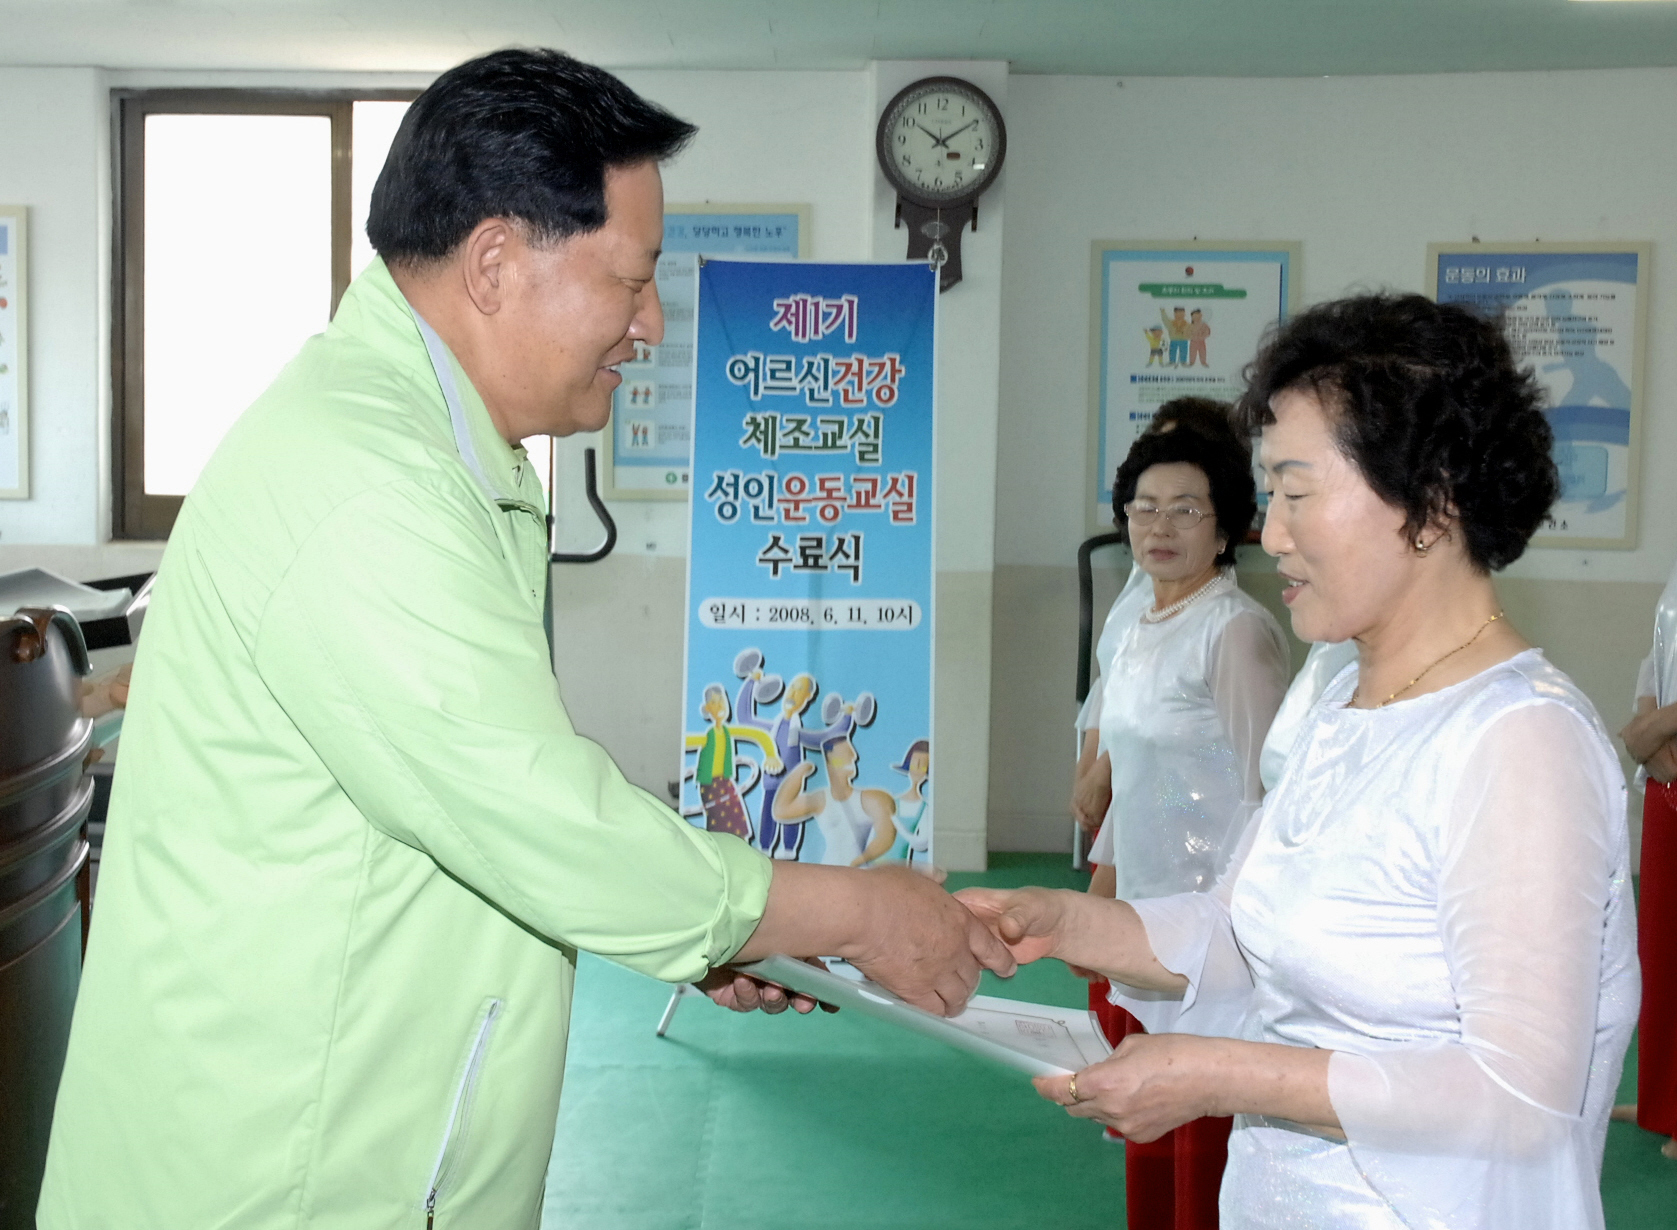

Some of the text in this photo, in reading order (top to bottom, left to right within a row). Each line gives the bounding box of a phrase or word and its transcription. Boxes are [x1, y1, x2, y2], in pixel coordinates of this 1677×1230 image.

[918, 102, 927, 115] 11
[937, 98, 949, 111] 12
[902, 116, 916, 129] 10
[898, 135, 907, 146] 9
[915, 168, 923, 181] 7
[934, 177, 943, 187] 6
[692, 226, 729, 238] 당당하고
[733, 226, 761, 238] 행복한
[1445, 266, 1527, 284] 운동의 효과
[771, 296, 857, 341] 제1기
[741, 413, 883, 463] 체조교실
[706, 472, 917, 523] 성인운동교실
[757, 534, 862, 584] 수료식
[710, 603, 745, 625] 일시
[768, 606, 815, 626] 2008.
[823, 606, 838, 625] 6.
[847, 606, 867, 626] 11.
[876, 605, 913, 627] 10시
